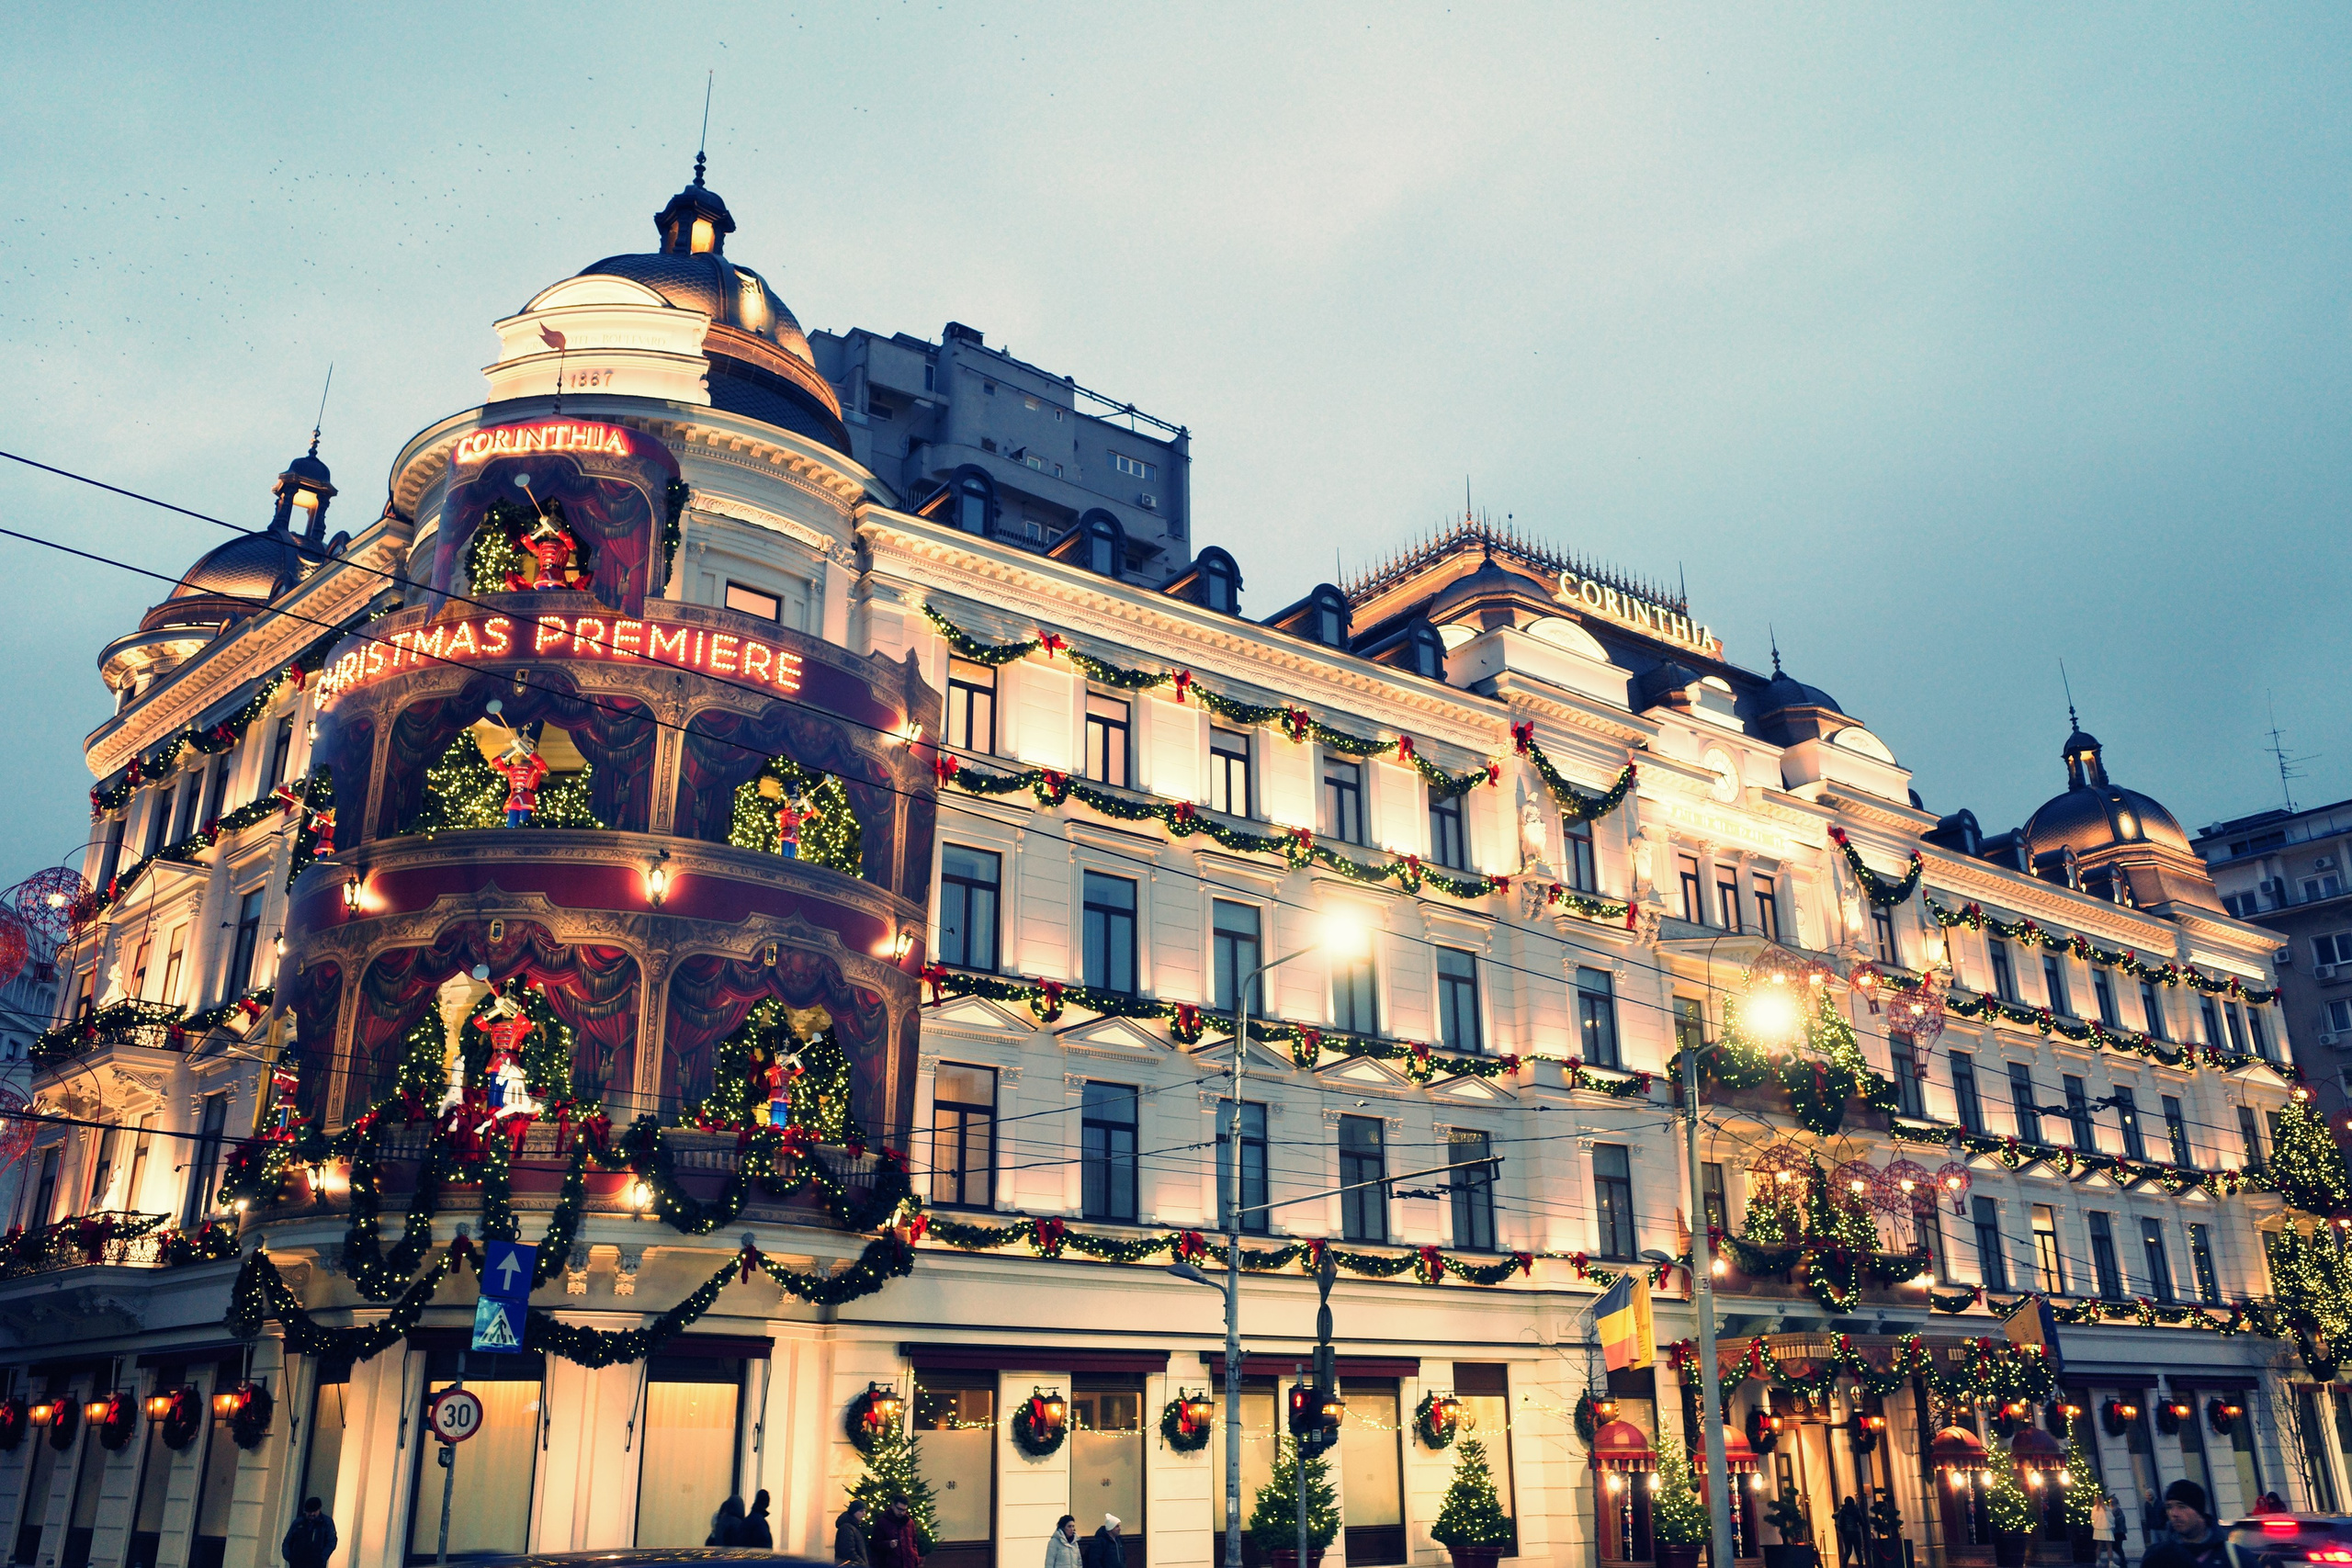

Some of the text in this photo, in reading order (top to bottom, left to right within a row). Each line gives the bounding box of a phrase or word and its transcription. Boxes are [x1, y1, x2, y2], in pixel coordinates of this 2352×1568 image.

[457, 424, 629, 462] CORINTHIA
[1559, 570, 1717, 652] CORINTHIA
[313, 615, 804, 710] CHRISTMAS PREMIERE
[443, 1404, 471, 1428] 30
